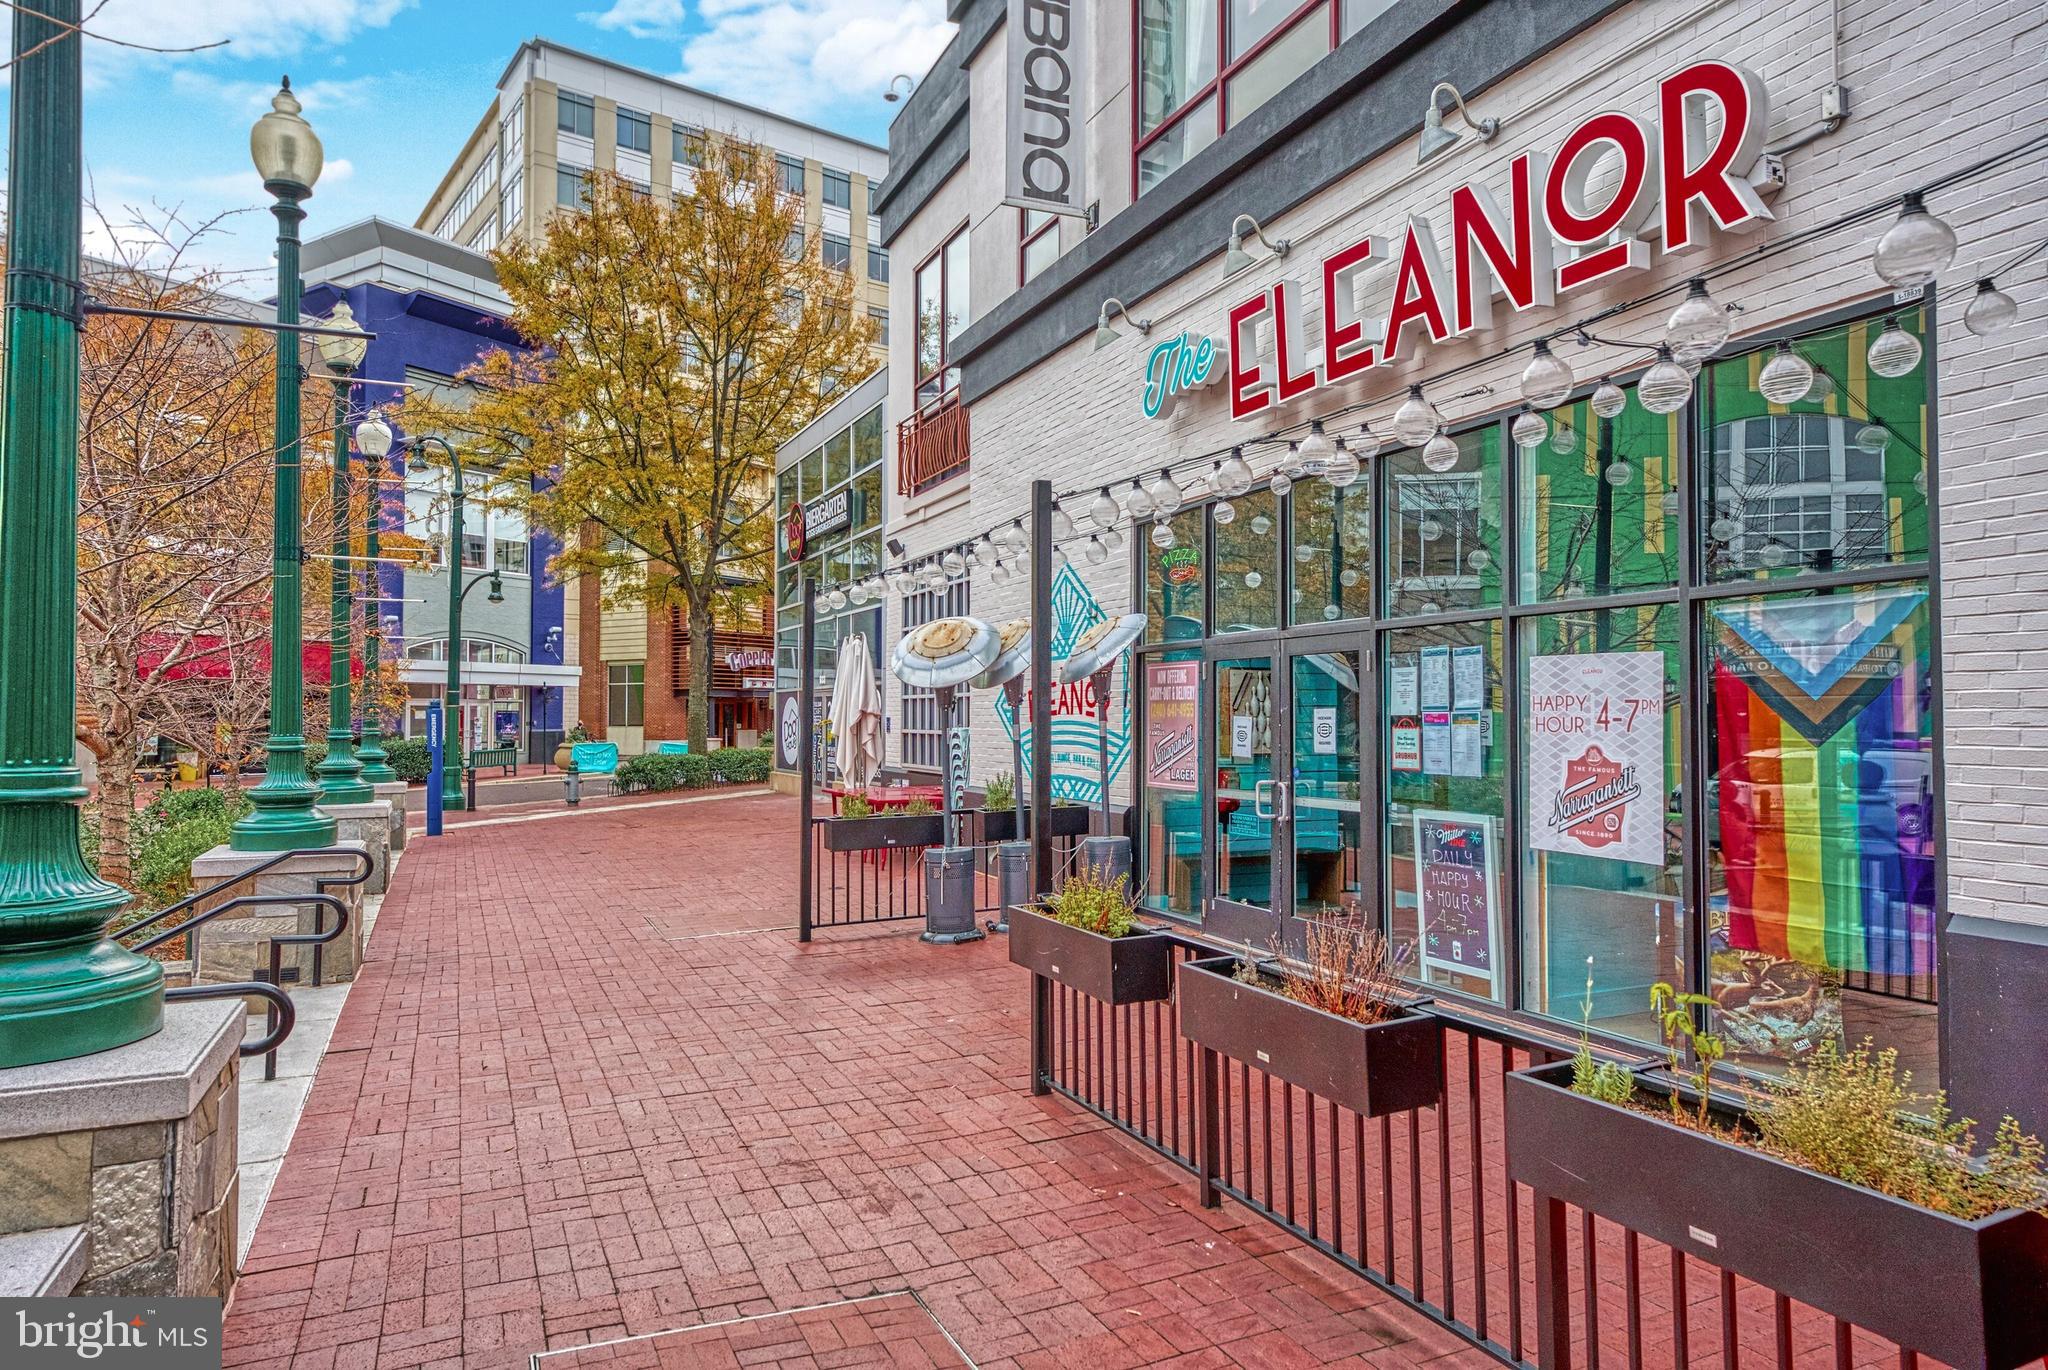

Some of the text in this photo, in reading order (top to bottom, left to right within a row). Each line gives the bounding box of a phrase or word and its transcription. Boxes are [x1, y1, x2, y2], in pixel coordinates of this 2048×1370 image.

[1023, 0, 1071, 204] Bana
[1143, 333, 1218, 420] The
[1227, 58, 1768, 422] ELEANOR
[805, 490, 847, 532] BIERGARTEN
[1161, 548, 1197, 568] PIZZA
[1157, 669, 1187, 684] NOW OFFERING
[1176, 685, 1195, 700] DELIVERY
[1532, 695, 1588, 712] HAPPY
[1535, 716, 1585, 733] HOUR
[1170, 768, 1195, 782] LAGER
[1548, 765, 1642, 833] Narragansett
[1436, 828, 1467, 845] Miller
[1432, 849, 1473, 869] DAILY
[1431, 870, 1470, 889] HAPPY
[1437, 890, 1473, 914] HOUR
